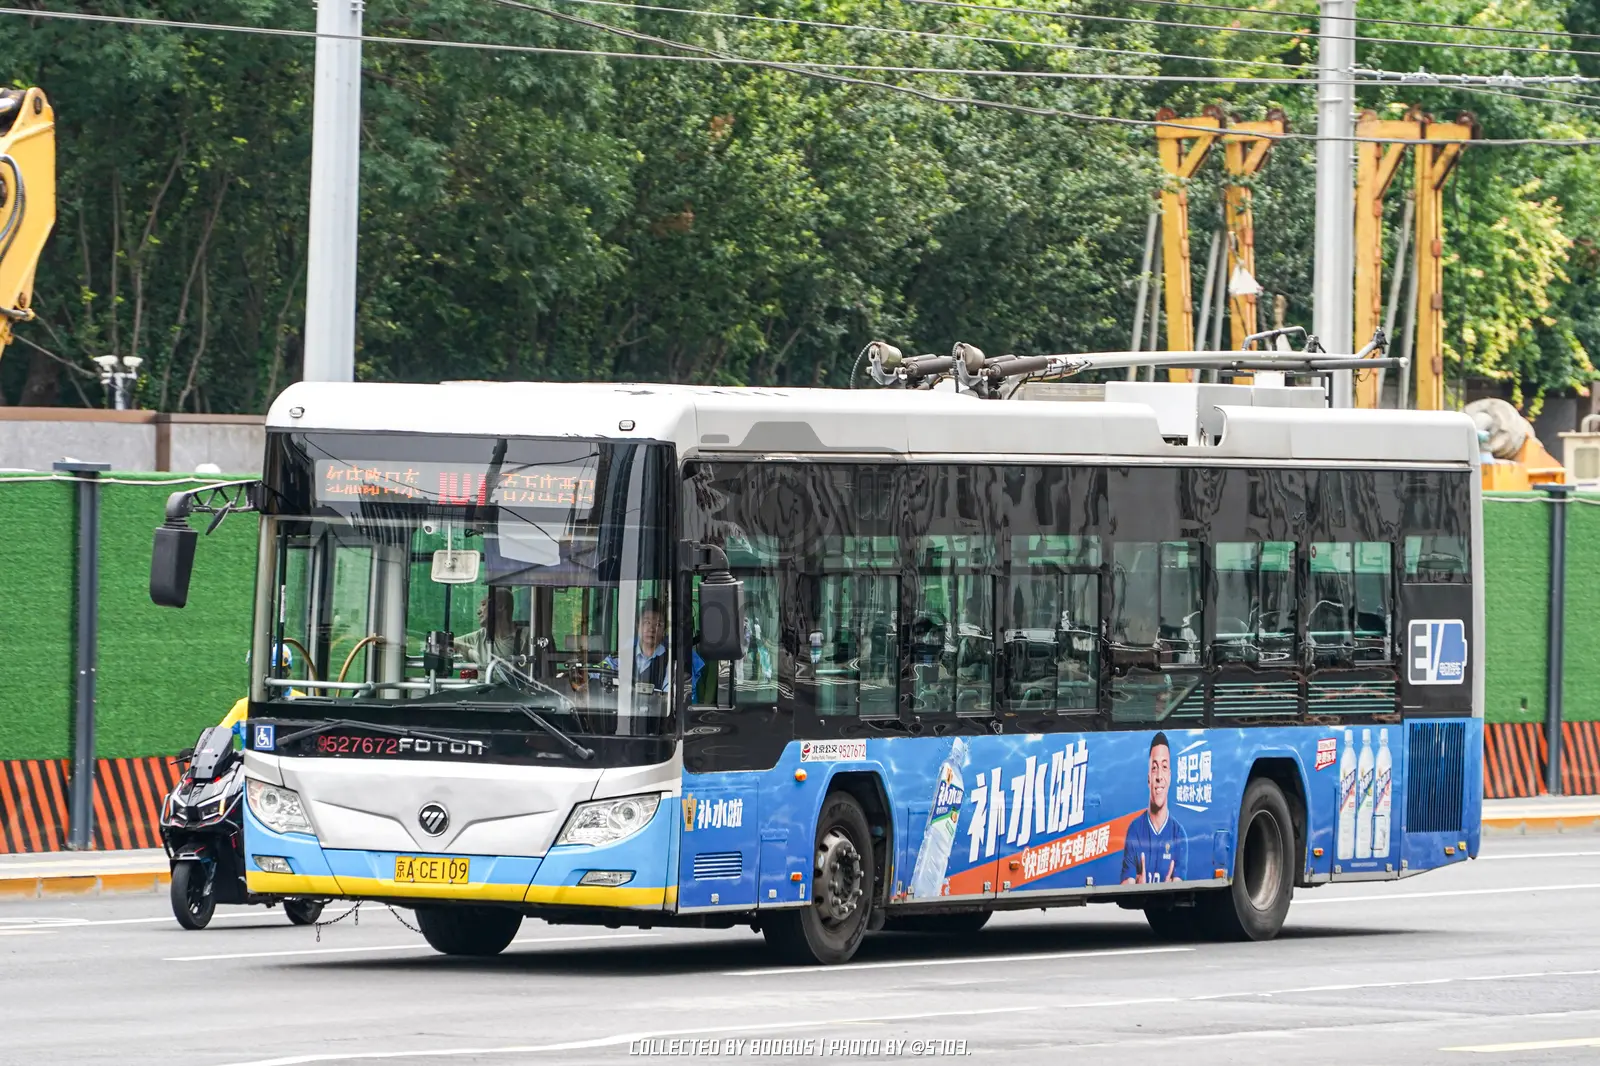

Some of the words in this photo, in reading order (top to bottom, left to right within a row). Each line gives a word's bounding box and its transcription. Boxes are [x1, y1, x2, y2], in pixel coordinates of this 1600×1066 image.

[318, 735, 398, 755] 9527672
[399, 737, 483, 756] FOTON
[812, 744, 838, 754] 北京公交
[838, 743, 866, 758] 9527672
[697, 798, 744, 830] 补水啦
[967, 739, 1089, 863] 补水啦
[1024, 825, 1111, 879] 快速补充电解质
